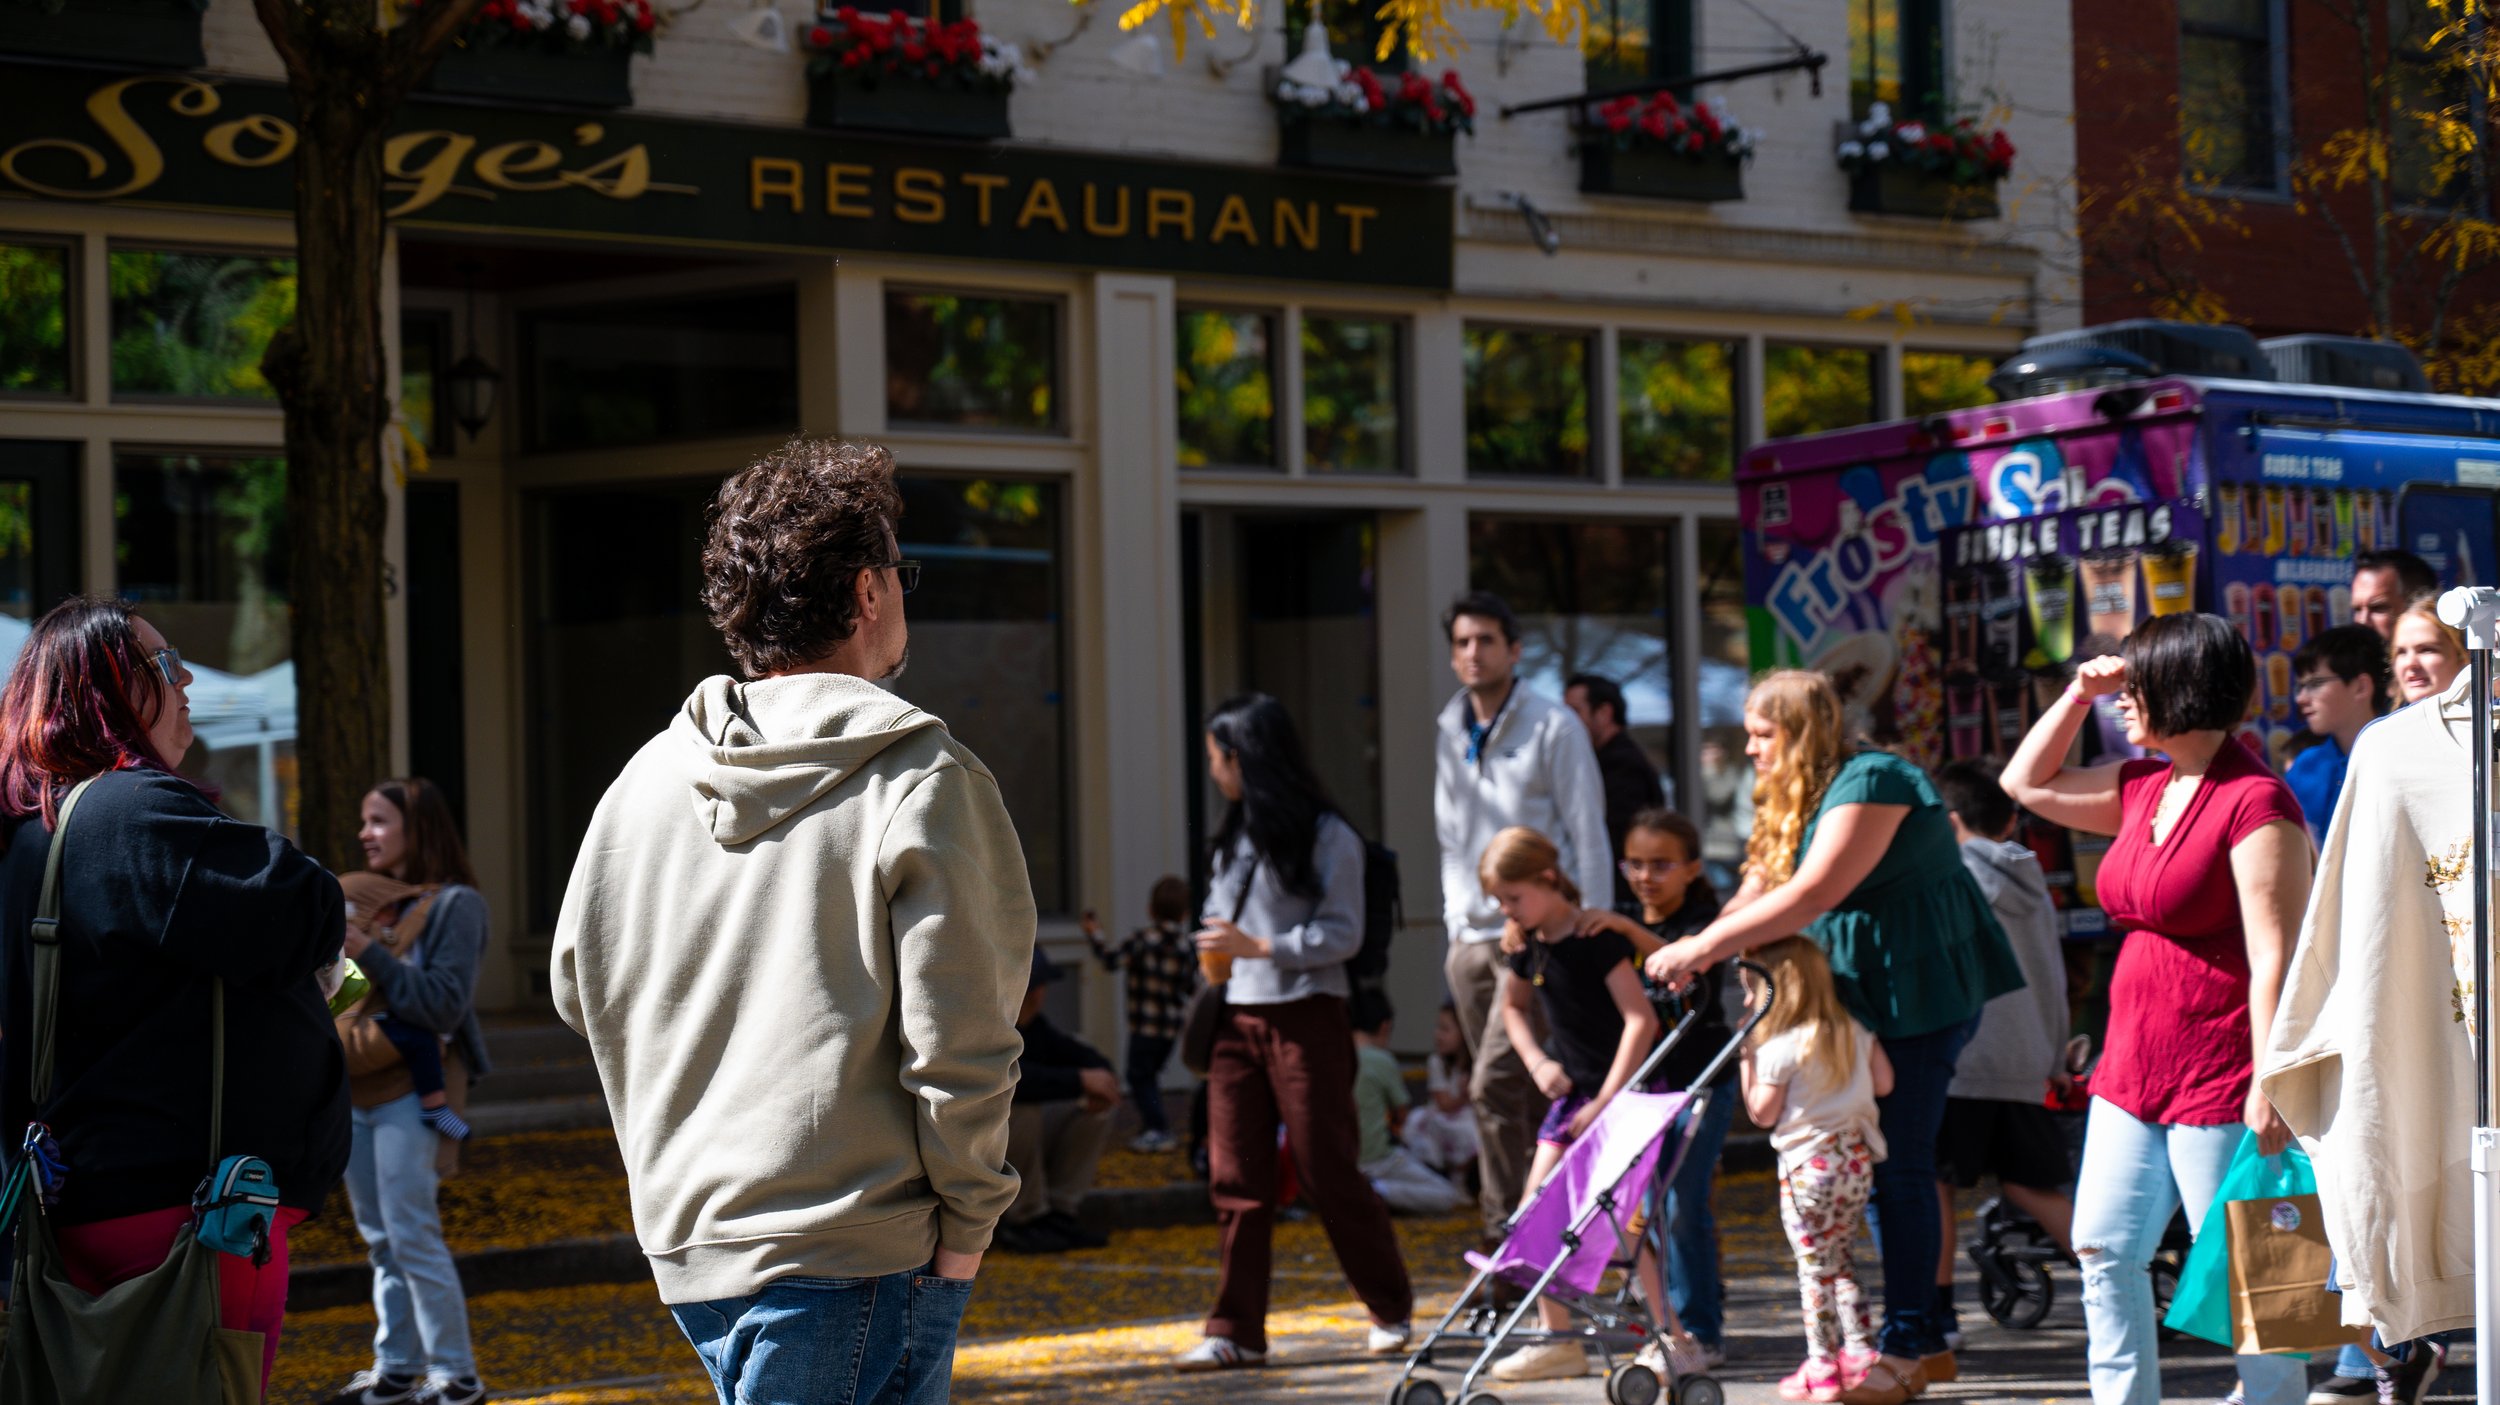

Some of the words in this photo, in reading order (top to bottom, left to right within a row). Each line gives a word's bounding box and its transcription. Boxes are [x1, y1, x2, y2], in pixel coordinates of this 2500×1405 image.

[0, 76, 699, 218] Soge's
[751, 156, 1379, 254] RESTAURANT
[2078, 504, 2173, 551] TEAS
